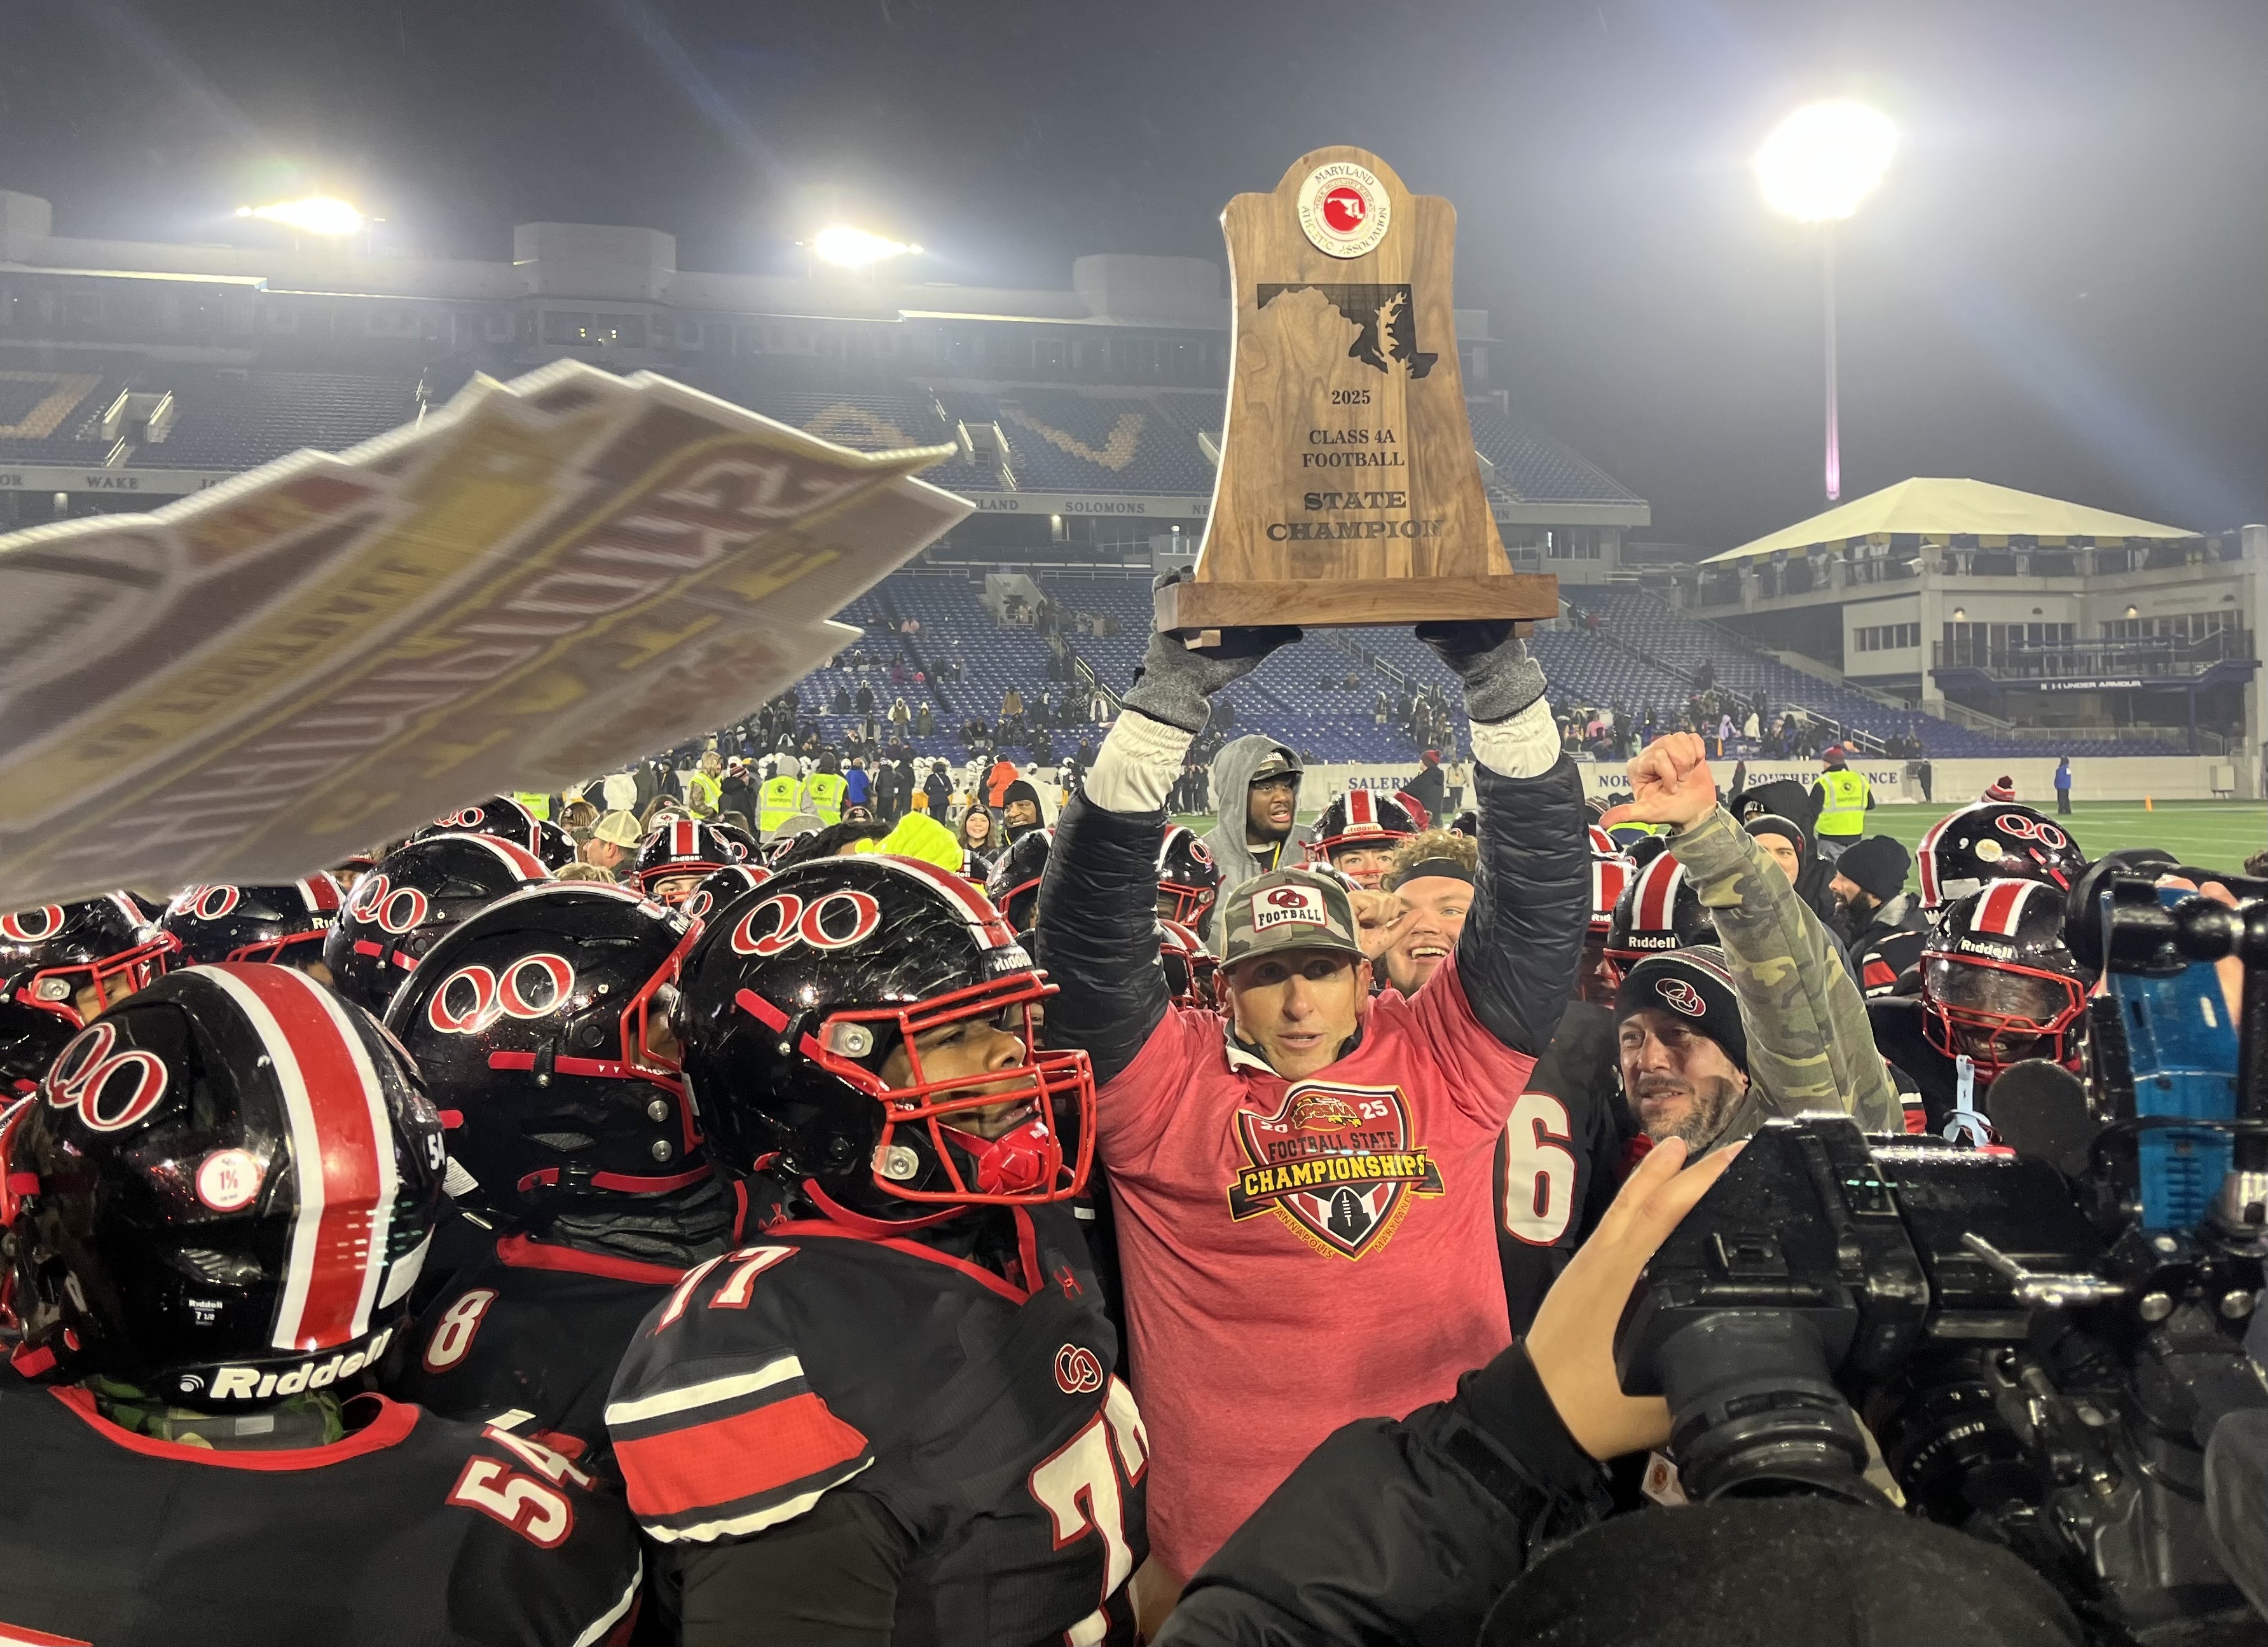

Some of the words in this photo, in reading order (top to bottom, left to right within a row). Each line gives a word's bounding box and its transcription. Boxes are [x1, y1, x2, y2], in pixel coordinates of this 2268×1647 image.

[1314, 166, 1374, 186] MARYLAND
[1331, 390, 1371, 405] 2025
[1309, 429, 1369, 444] CLASS
[1374, 429, 1396, 443] 4A
[1302, 452, 1405, 467] FOOTBALL
[87, 477, 139, 489] WAKE
[976, 500, 1019, 510] LAND
[1066, 502, 1145, 514] SOLOMONS
[1304, 491, 1406, 510] STATE
[1266, 519, 1445, 541] CHAMPION
[1349, 777, 1413, 789] SALERN
[1749, 773, 1819, 786] SOUTHER
[1959, 837, 1969, 850] 9
[731, 891, 883, 957] QO
[1258, 909, 1321, 927] FOOTBALL
[1628, 936, 1675, 948] Riddell
[1961, 940, 2013, 959] Riddell
[428, 952, 575, 1034] QO
[1359, 1100, 1389, 1120] 25
[1261, 1121, 1288, 1133] 20
[427, 1131, 445, 1170] 54
[1268, 1132, 1347, 1162] FOOTBALL
[1351, 1131, 1398, 1149] STATE
[1244, 1153, 1426, 1196] CHAMPIONSHIPS
[1503, 1091, 1577, 1247] 6
[1373, 1193, 1412, 1254] MARYLAND
[1274, 1208, 1335, 1259] ANNAPOLIS
[189, 1299, 223, 1309] Riddell
[422, 1288, 500, 1374] 8
[210, 1327, 393, 1398] Riddell
[446, 1425, 596, 1549] 54
